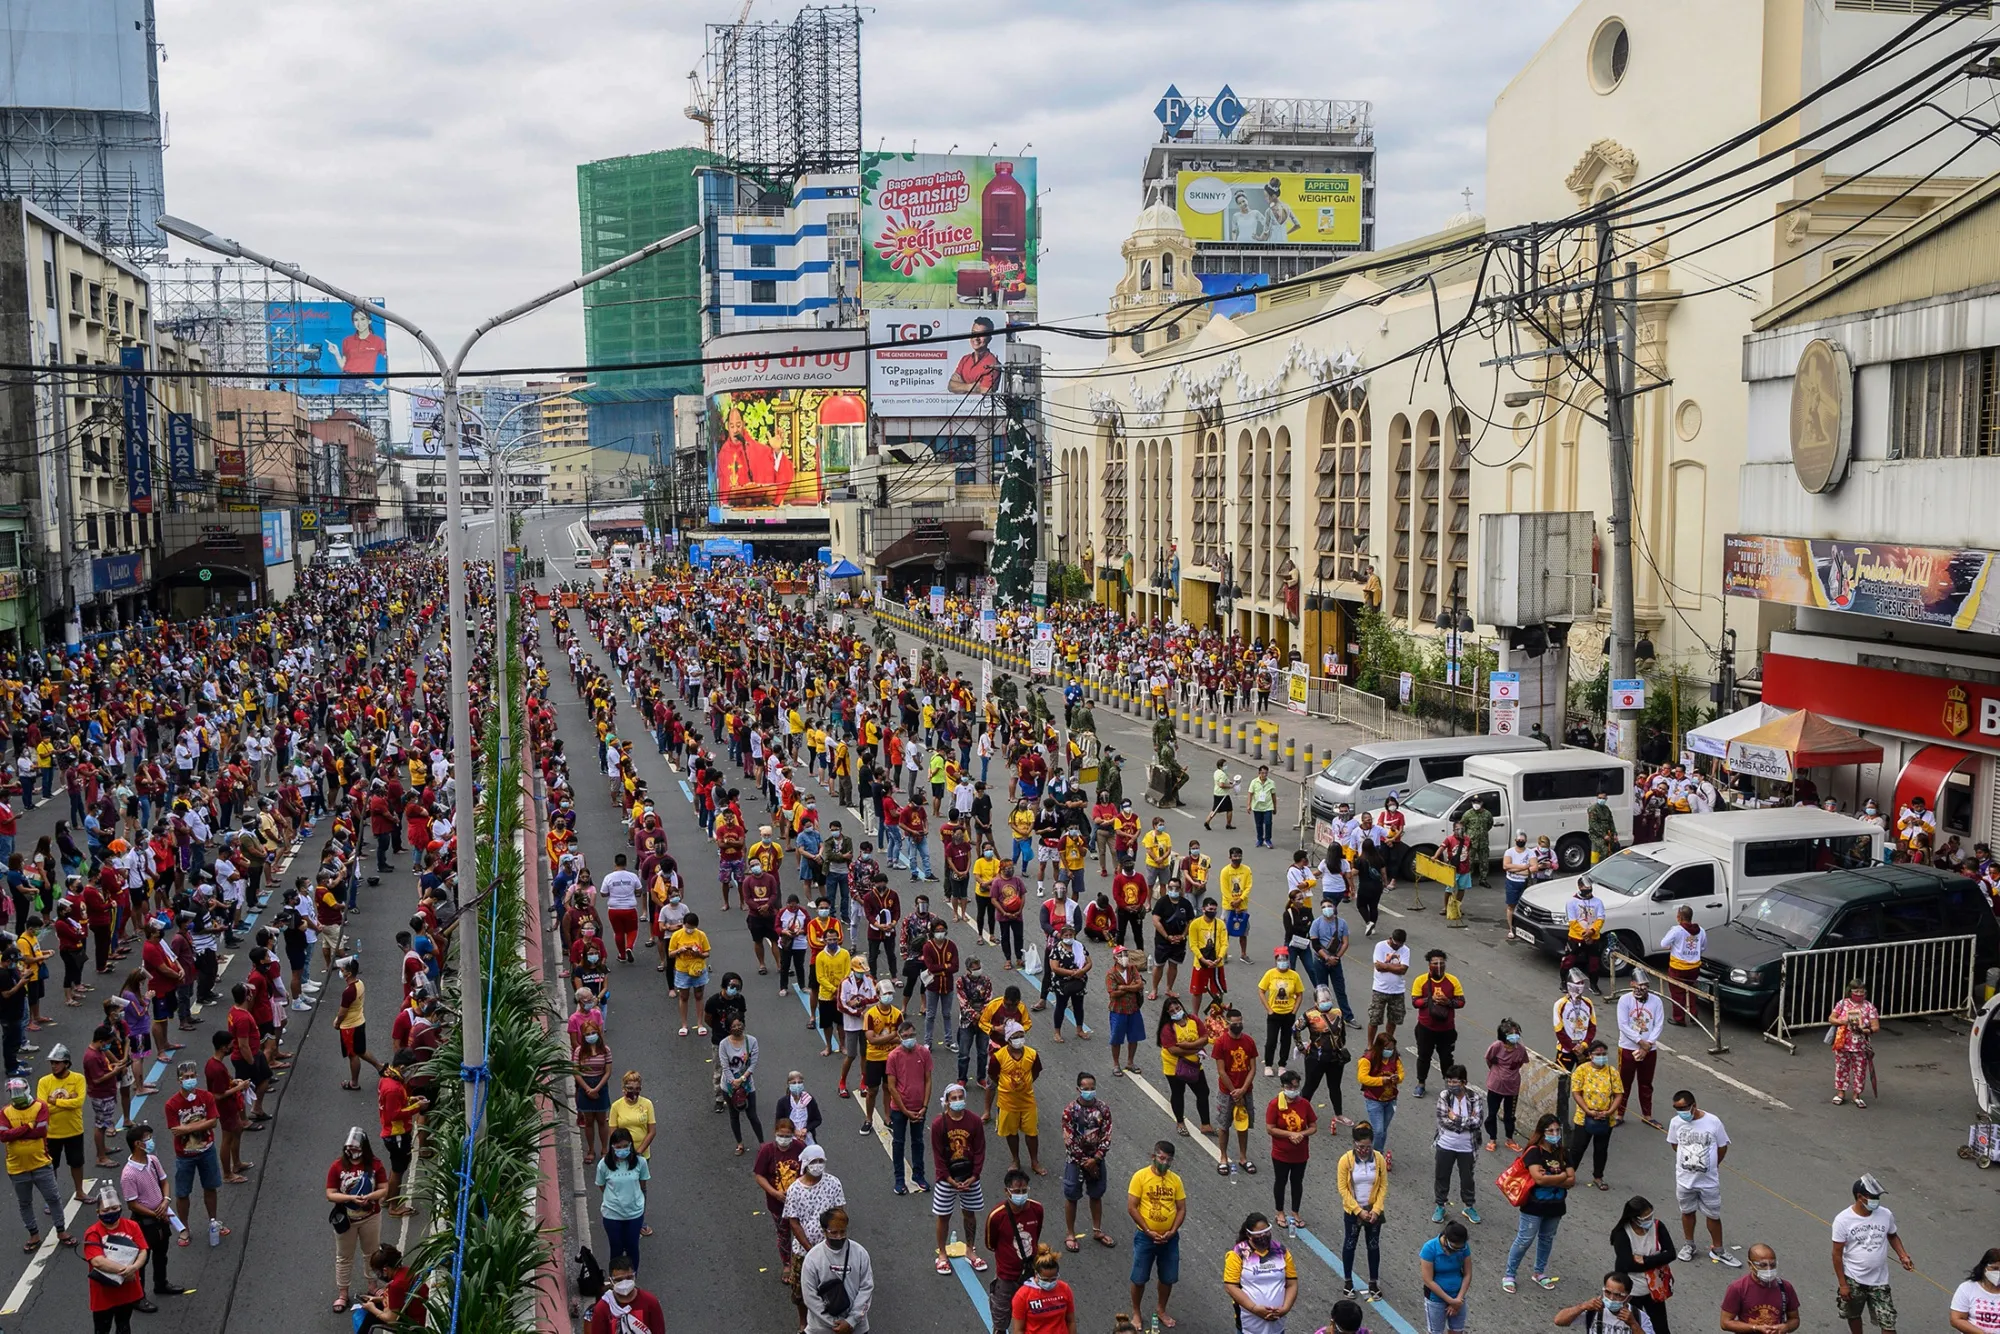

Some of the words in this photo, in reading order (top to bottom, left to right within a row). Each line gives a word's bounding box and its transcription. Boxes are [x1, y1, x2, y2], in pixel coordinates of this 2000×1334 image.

[1163, 98, 1186, 126] F
[1193, 105, 1206, 118] &
[1216, 95, 1238, 127] C
[1247, 98, 1375, 128] TOWER
[888, 179, 914, 190] Bago
[915, 176, 933, 188] ang
[936, 170, 965, 183] lahat,
[1307, 182, 1347, 191] APPETON
[880, 184, 969, 209] Cleansing
[1189, 191, 1226, 200] SKINNY?
[1298, 194, 1333, 203] WEIGHT
[1333, 195, 1356, 203] GAIN
[912, 200, 957, 216] muna!
[896, 226, 973, 251] redjuice
[943, 241, 981, 256] muna!
[886, 323, 933, 343] TGP
[780, 346, 851, 372] drug
[728, 375, 751, 384] GAMOT
[752, 374, 764, 382] AY
[765, 373, 800, 381] LAGING
[803, 372, 832, 380] BAGO
[881, 365, 943, 376] TGPagpagaling
[889, 379, 899, 387] ng
[900, 378, 935, 386] Pilipinas
[127, 376, 147, 496] VILLARICA
[172, 415, 191, 478] ABLAZA
[1905, 554, 1933, 587] 2021
[1884, 600, 1907, 617] HESUS
[1329, 664, 1346, 675] EXIT
[1730, 758, 1757, 770] PAMISA
[1760, 764, 1787, 776] BOOTH
[1029, 1299, 1043, 1309] TH
[633, 1320, 649, 1333] NIKE
